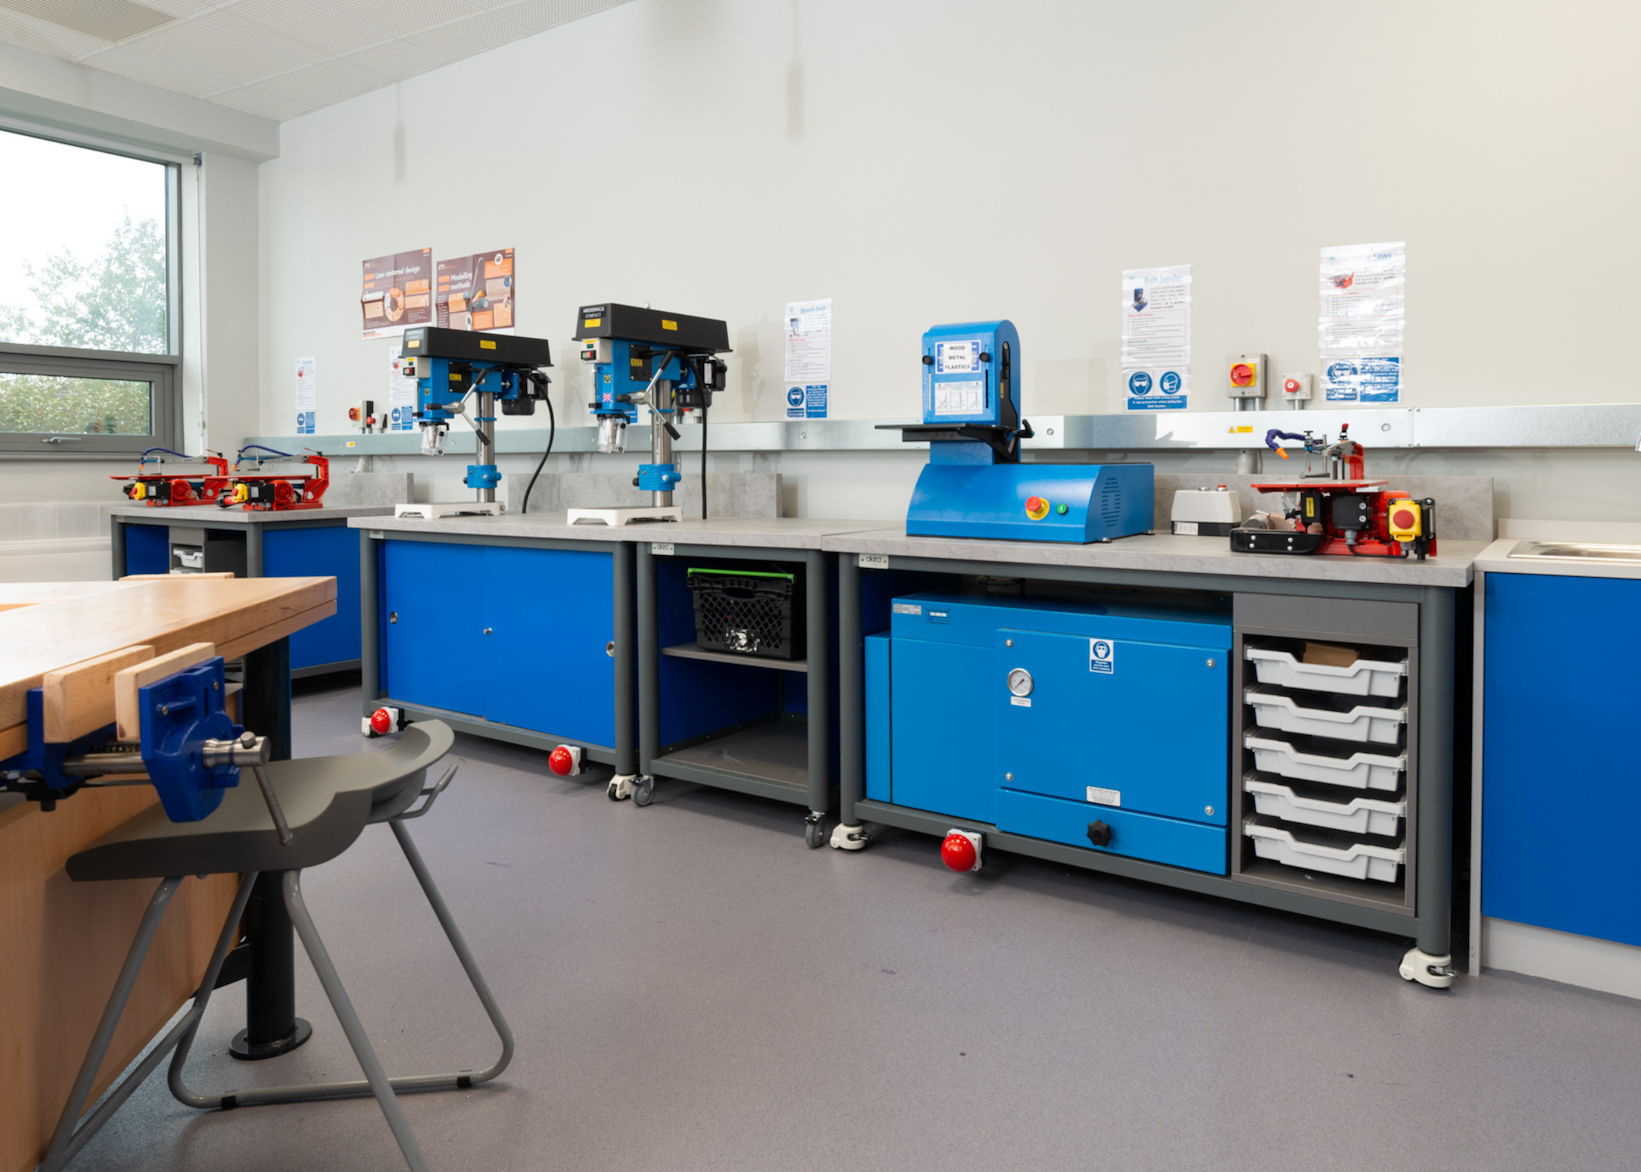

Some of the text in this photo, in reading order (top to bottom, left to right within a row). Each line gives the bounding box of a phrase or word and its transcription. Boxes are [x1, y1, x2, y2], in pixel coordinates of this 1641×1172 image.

[404, 266, 420, 274] design
[450, 272, 472, 281] Modelling
[450, 281, 470, 290] methods
[866, 554, 882, 562] akira
